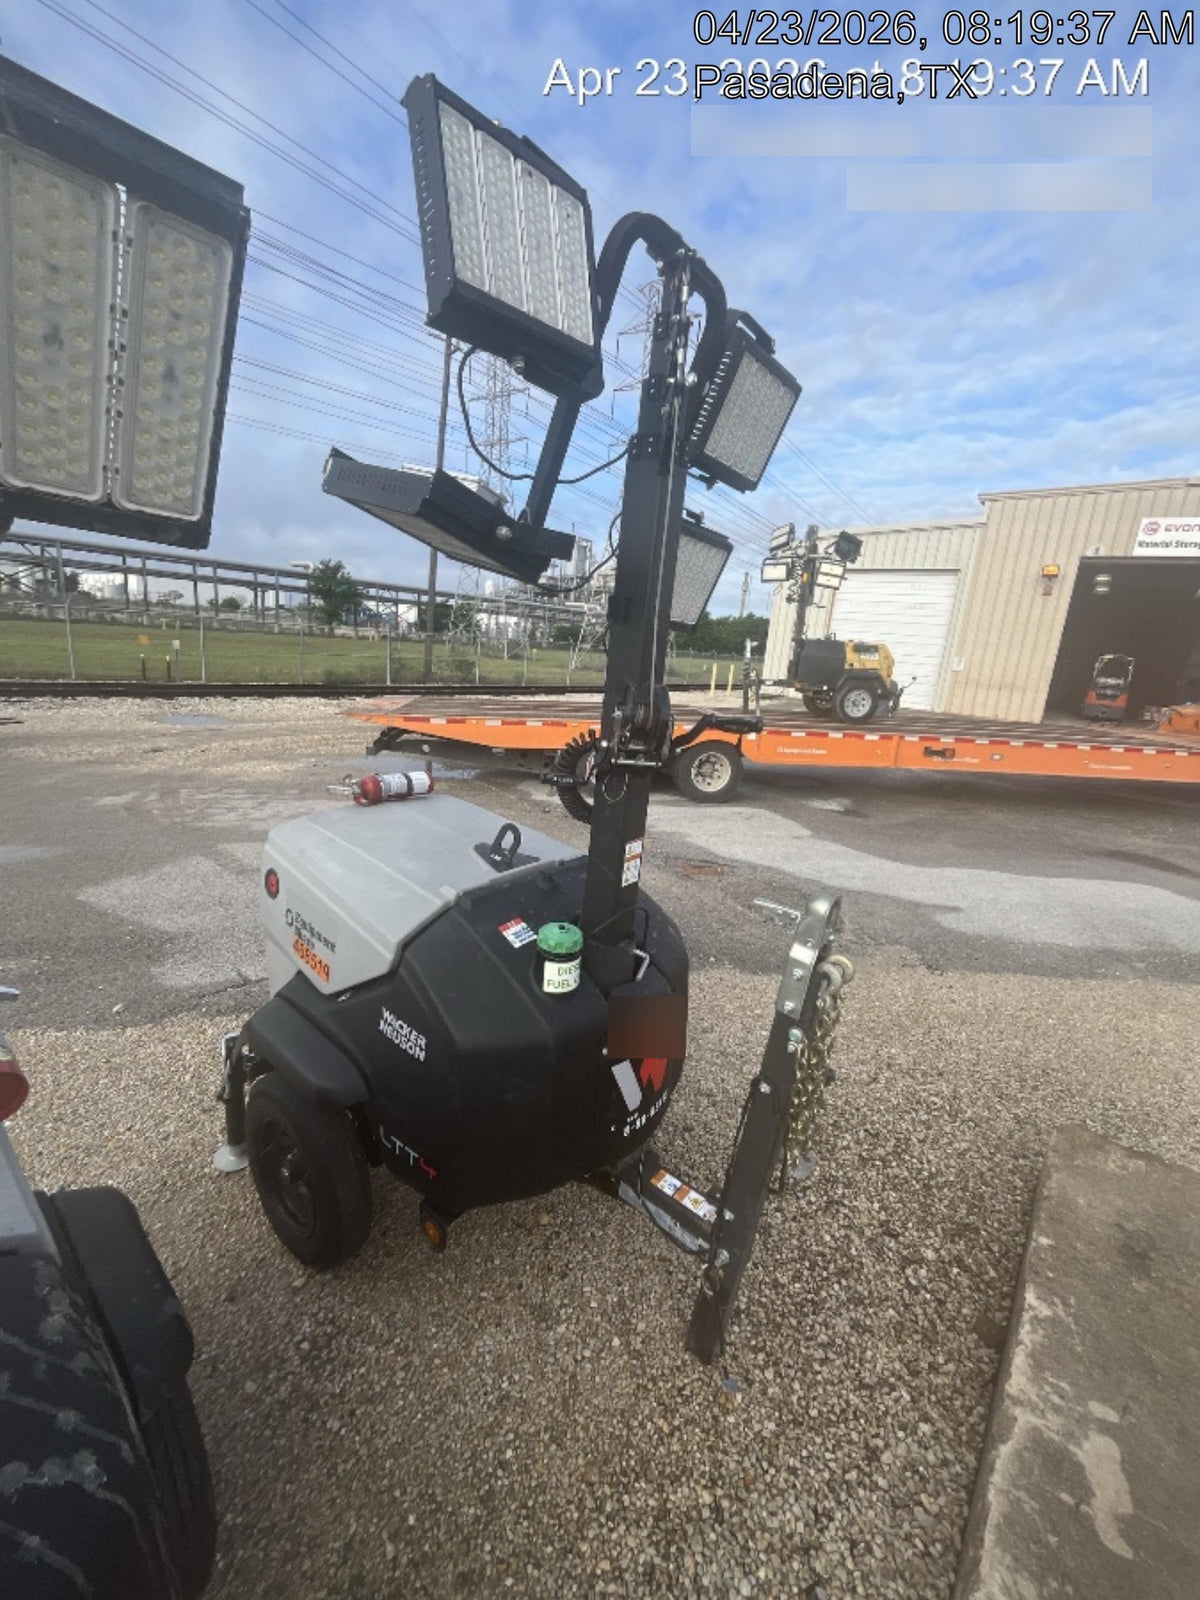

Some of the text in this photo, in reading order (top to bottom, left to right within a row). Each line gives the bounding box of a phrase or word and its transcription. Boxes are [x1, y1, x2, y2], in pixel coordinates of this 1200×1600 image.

[547, 978, 572, 989] FUEL
[378, 1019, 427, 1063] NEUSON
[381, 1006, 428, 1050] WACKER
